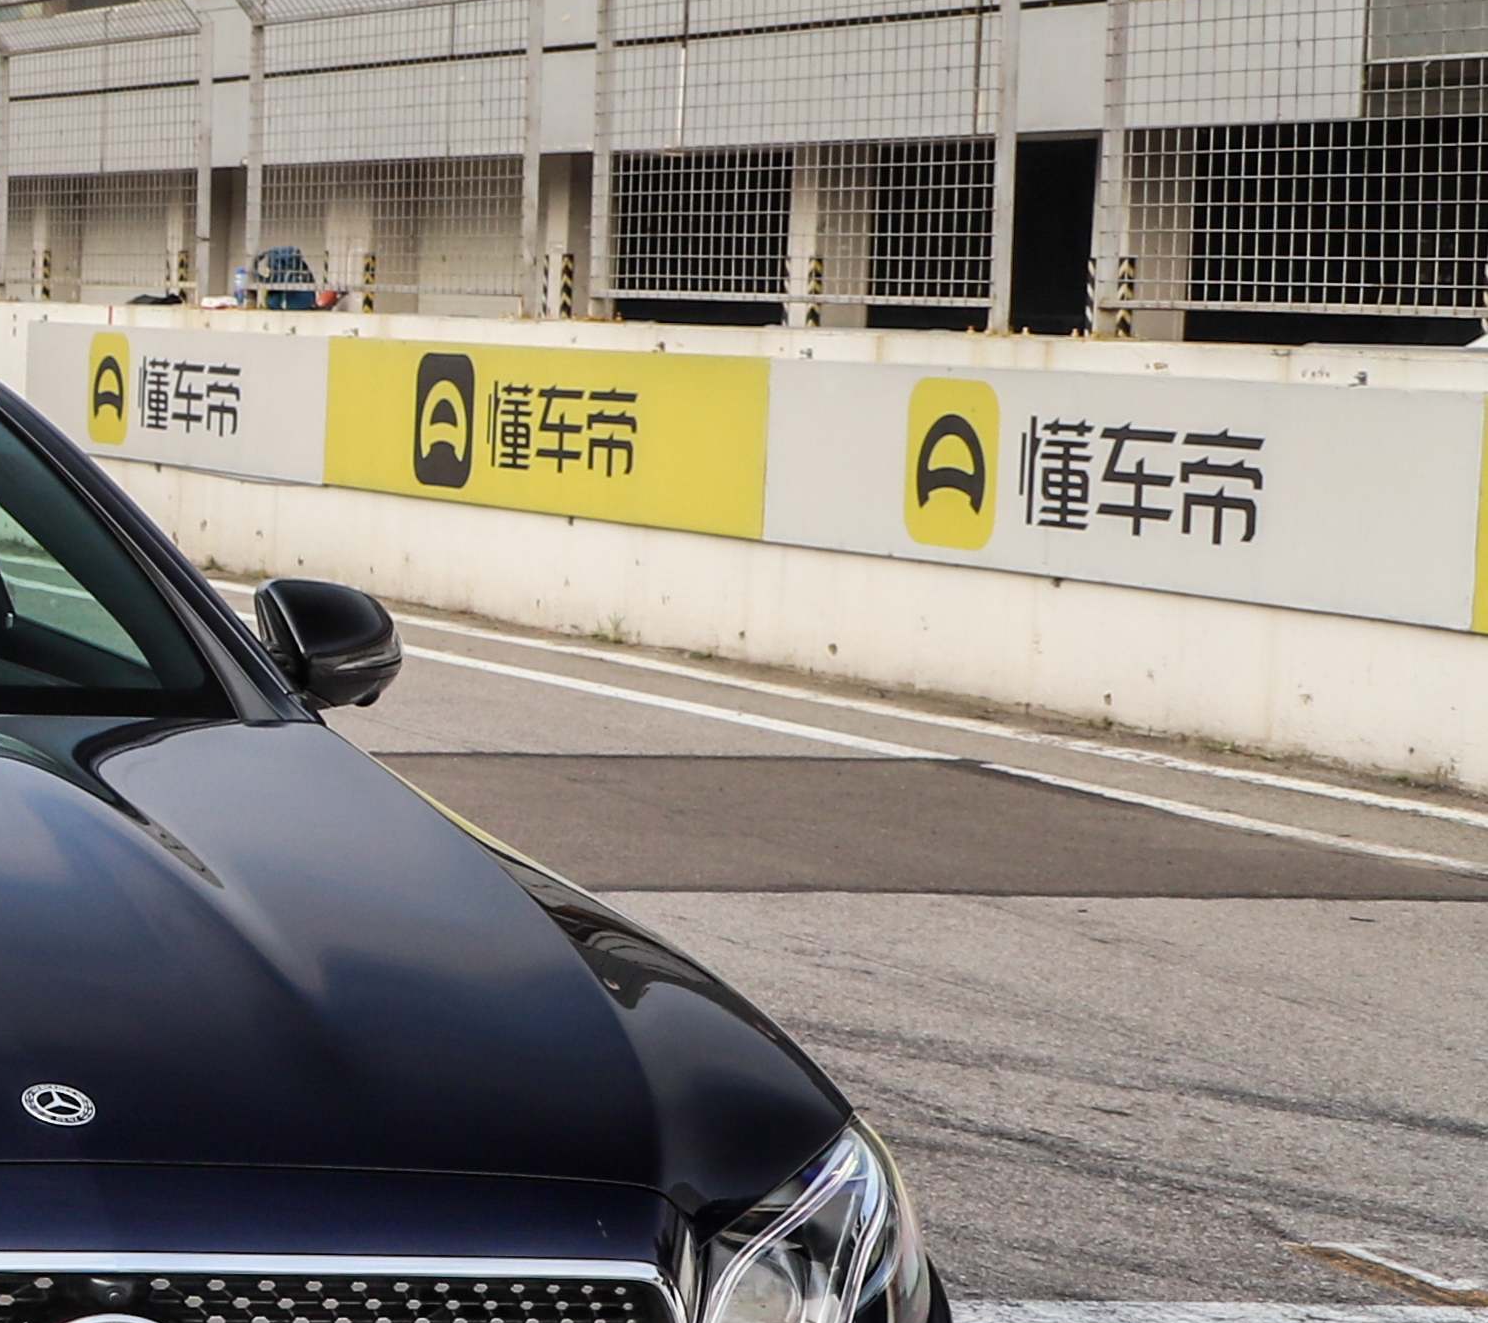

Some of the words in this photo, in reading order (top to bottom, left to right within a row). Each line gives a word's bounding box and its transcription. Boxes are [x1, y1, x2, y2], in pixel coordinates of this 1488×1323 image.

[137, 356, 242, 437] 懂车帝
[486, 380, 639, 478] 懂车帝
[1019, 415, 1266, 546] 懂车帝
